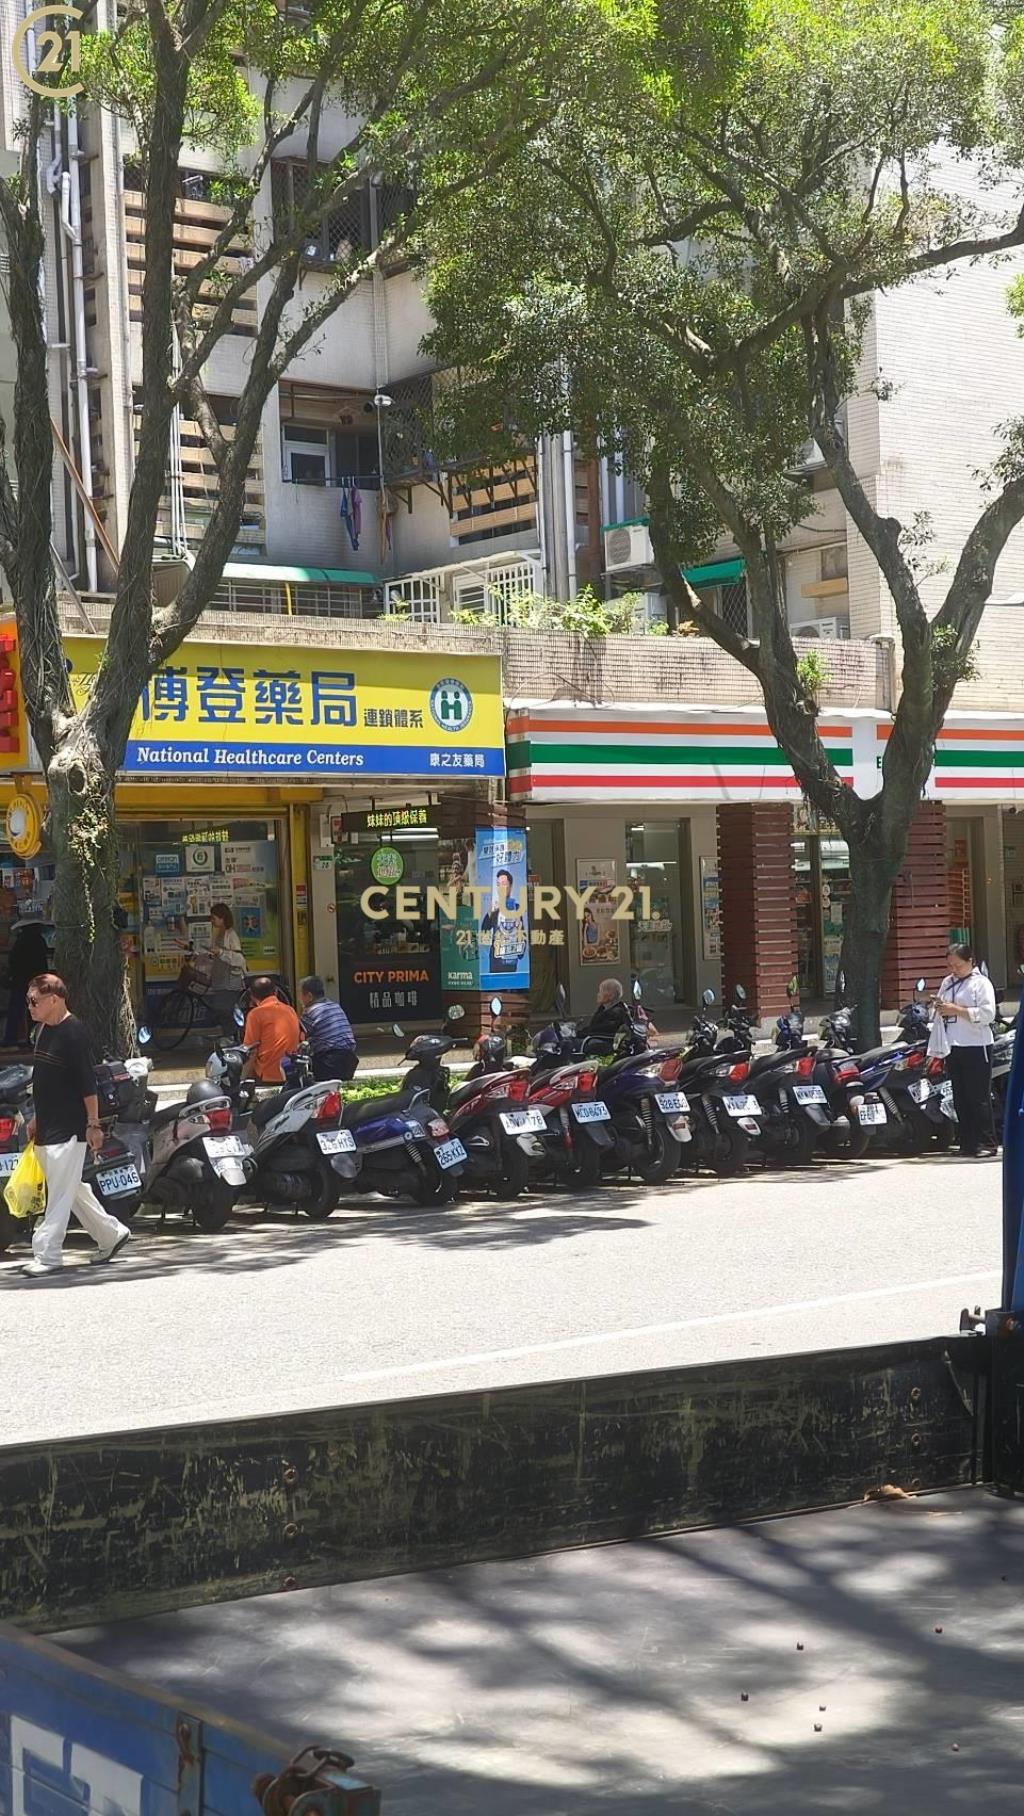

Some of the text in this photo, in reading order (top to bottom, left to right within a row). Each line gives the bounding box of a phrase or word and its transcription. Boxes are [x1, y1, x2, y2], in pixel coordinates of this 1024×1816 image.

[141, 666, 357, 727] 博登藥局
[364, 708, 424, 729] 連鎖體系
[136, 747, 364, 766] National Healthcare Centers
[429, 752, 485, 768] 康之友藥局
[354, 969, 429, 984] CITY PRIMA
